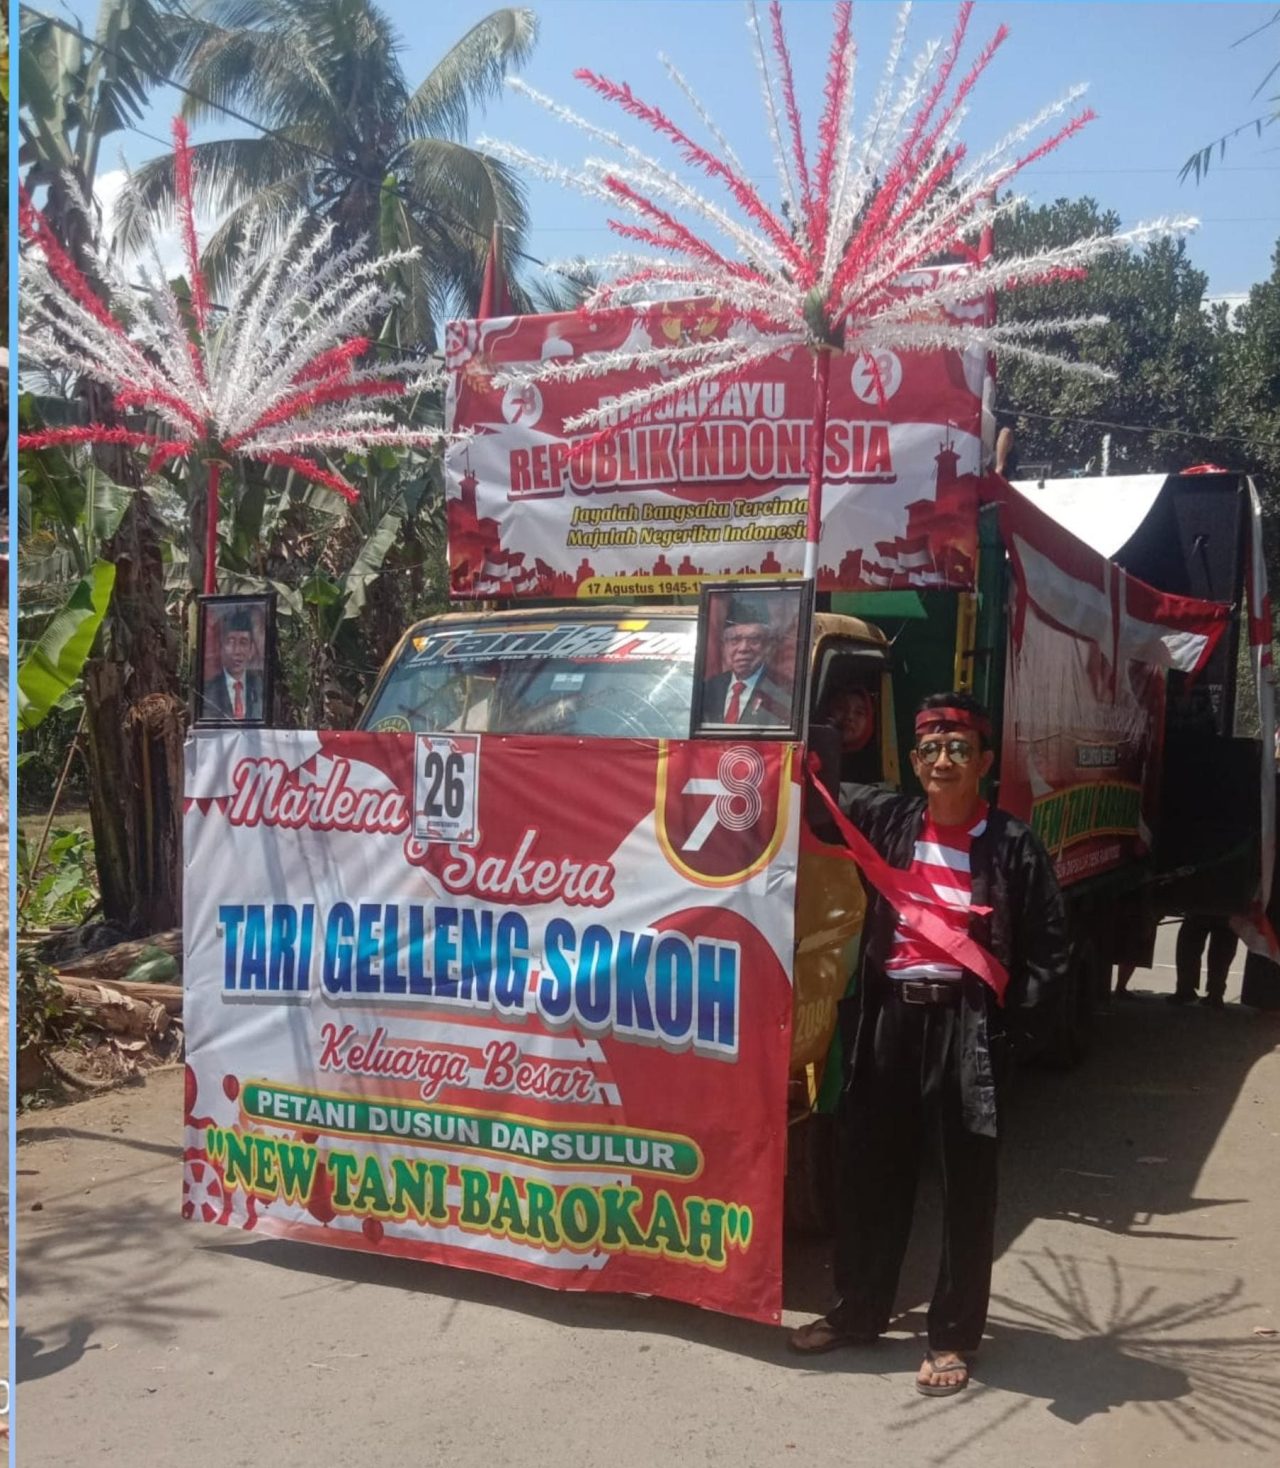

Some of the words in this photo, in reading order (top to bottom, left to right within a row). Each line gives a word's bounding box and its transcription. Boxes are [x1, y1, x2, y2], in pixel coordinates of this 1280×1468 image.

[507, 422, 677, 497] REPUBLIK
[567, 527, 637, 550] Majulah
[639, 524, 721, 547] Negeriku
[723, 520, 809, 542] Indonesi
[570, 502, 639, 526] Jayalah
[641, 499, 730, 523] Bangsaku
[733, 496, 808, 517] Tercinta
[587, 583, 601, 594] 17
[604, 582, 654, 595] Agustus
[658, 581, 702, 593] 1945-1
[228, 757, 410, 832] Marlena
[424, 752, 465, 818] 26
[680, 744, 765, 852] 78
[442, 828, 613, 904] Sakera
[219, 903, 314, 995] TARI
[322, 903, 529, 1011] GELLENG
[536, 917, 740, 1048] SOKOH
[320, 1023, 468, 1101] Keluarga
[481, 1040, 595, 1100] Besar
[257, 1090, 357, 1131] PETANI
[367, 1105, 481, 1147] DUSUN
[490, 1120, 677, 1172] DAPSULUR
[326, 1149, 451, 1224] TANI
